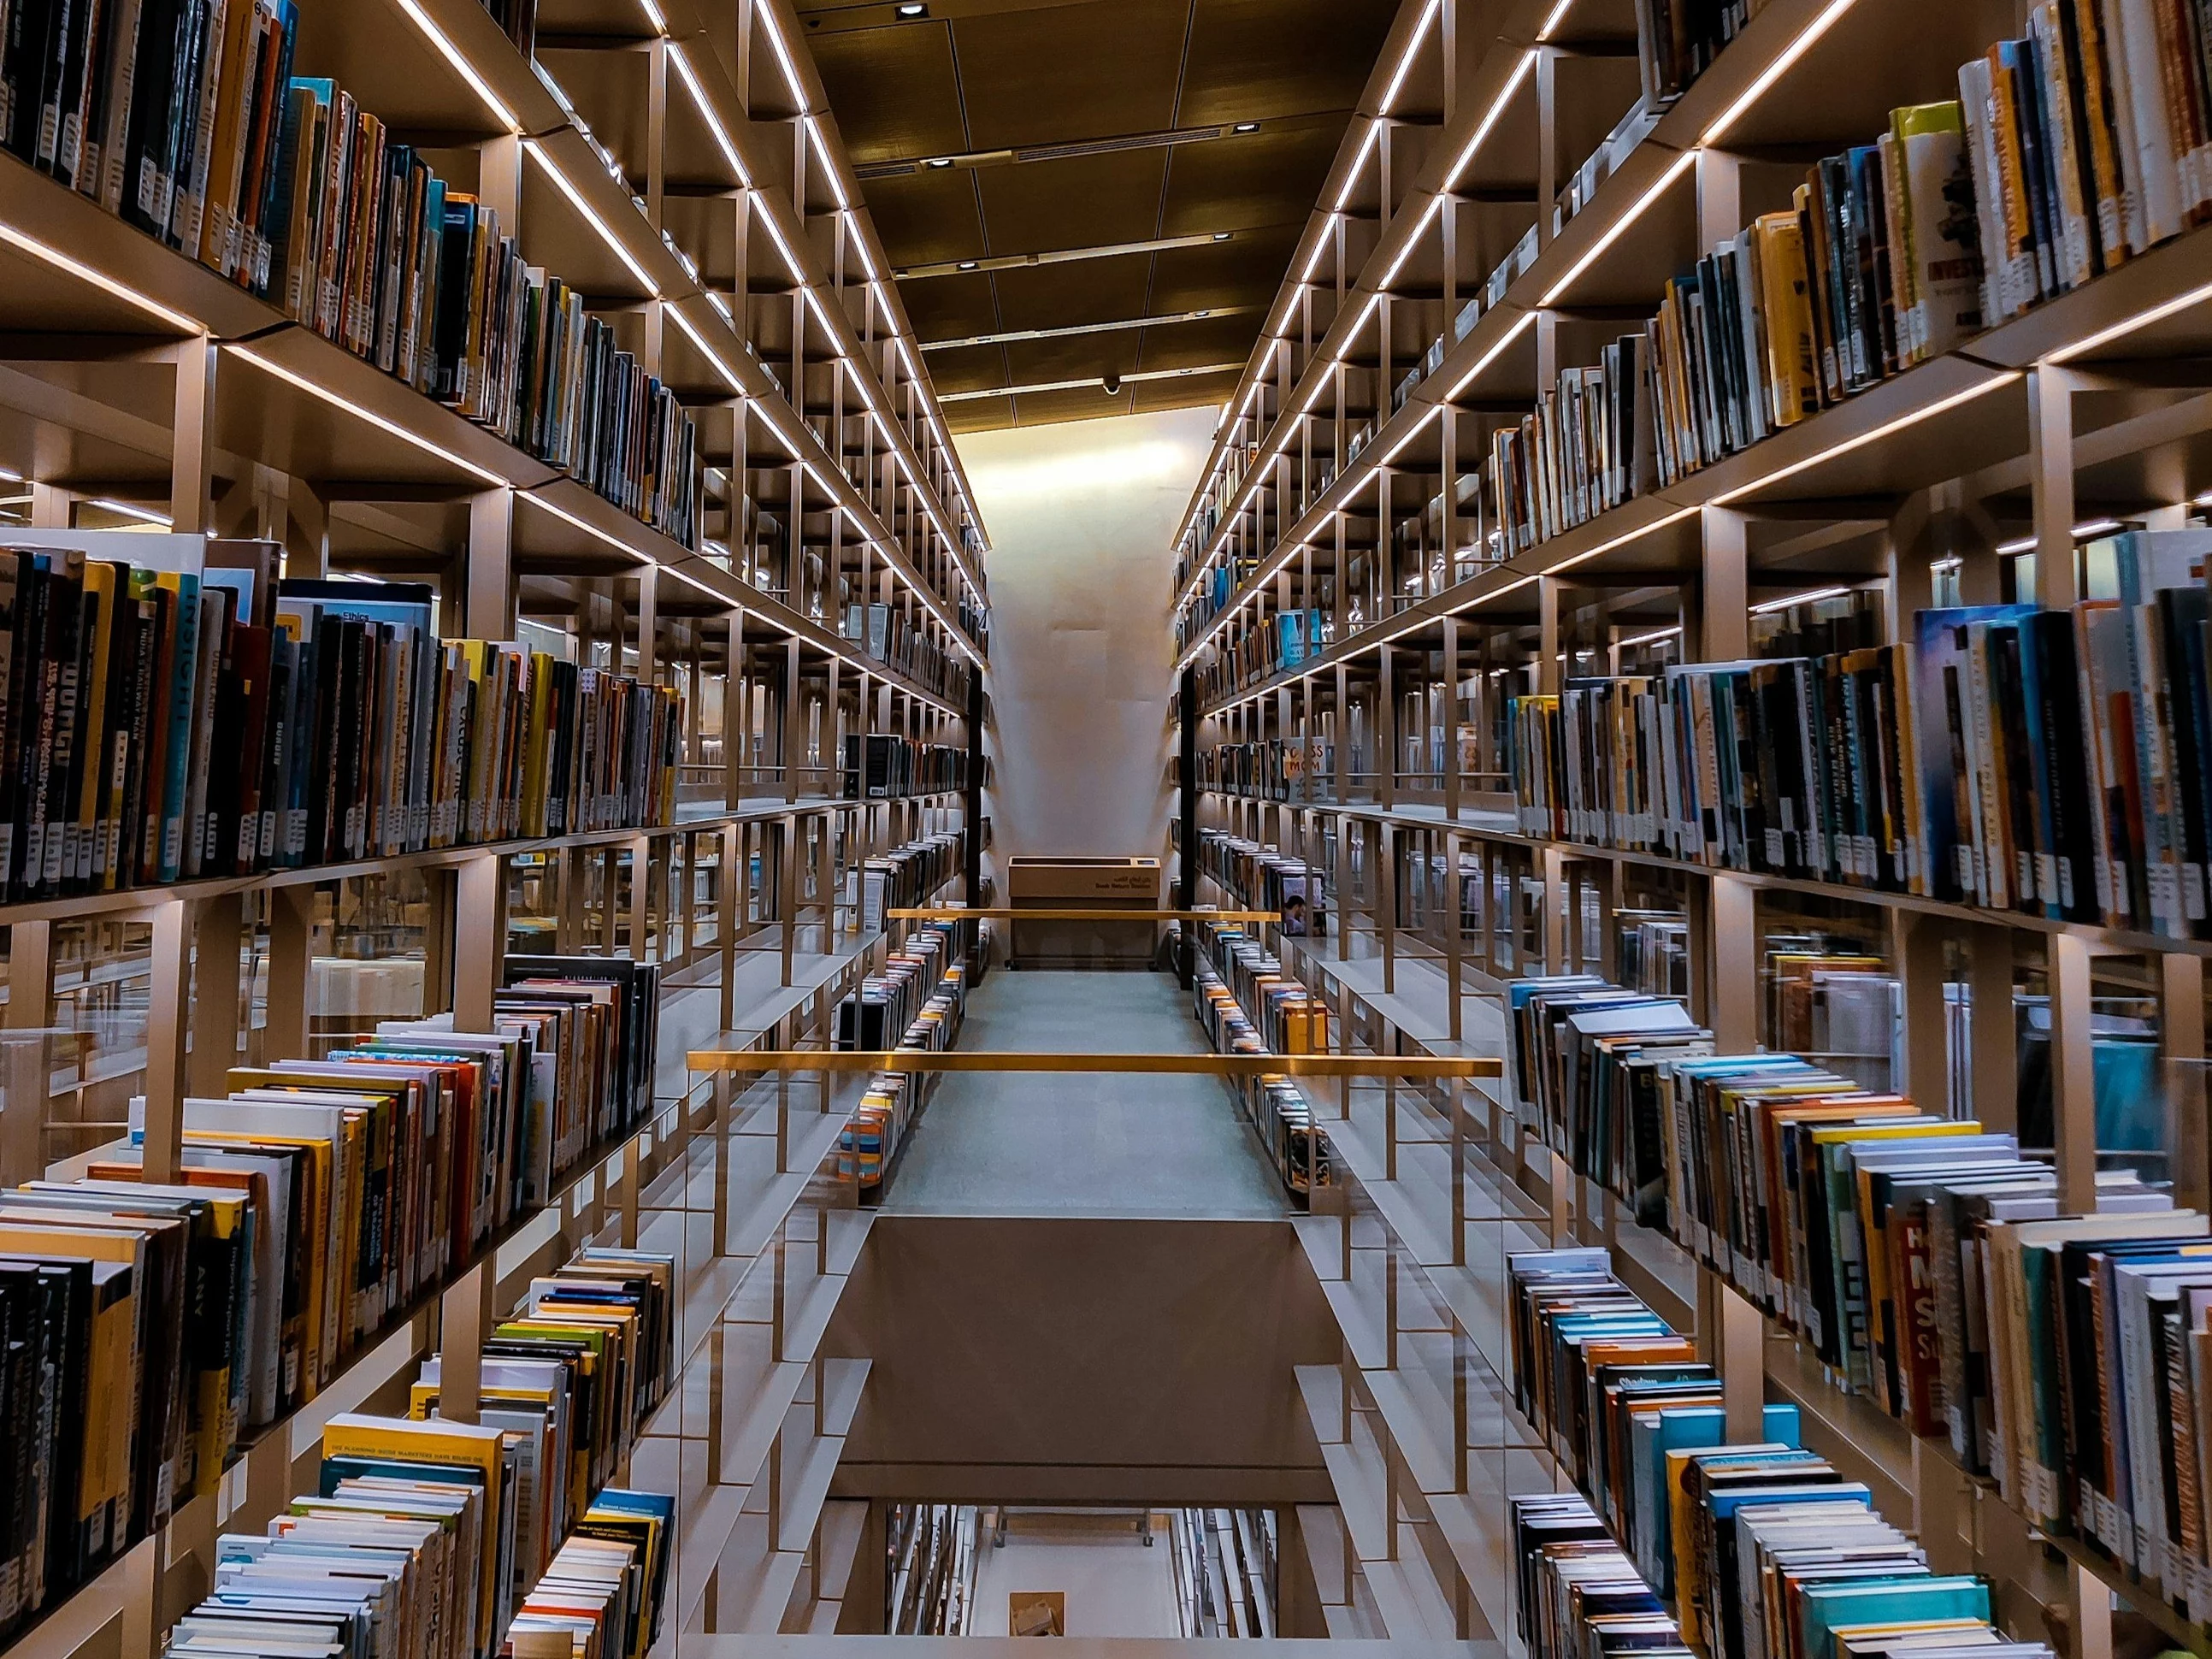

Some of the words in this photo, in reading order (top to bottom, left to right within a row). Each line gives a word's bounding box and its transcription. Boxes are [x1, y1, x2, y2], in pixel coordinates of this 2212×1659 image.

[343, 611, 369, 622] Ethics
[177, 593, 198, 723] INSIGHT
[132, 717, 142, 741] MAN
[1841, 677, 1854, 739] INVEST
[274, 722, 285, 765] BURDEN
[457, 706, 468, 765] excuse
[1849, 745, 1856, 765] TO
[1851, 770, 1861, 804] WIN
[195, 1266, 206, 1317] ANY
[226, 1246, 239, 1337] Import/Export
